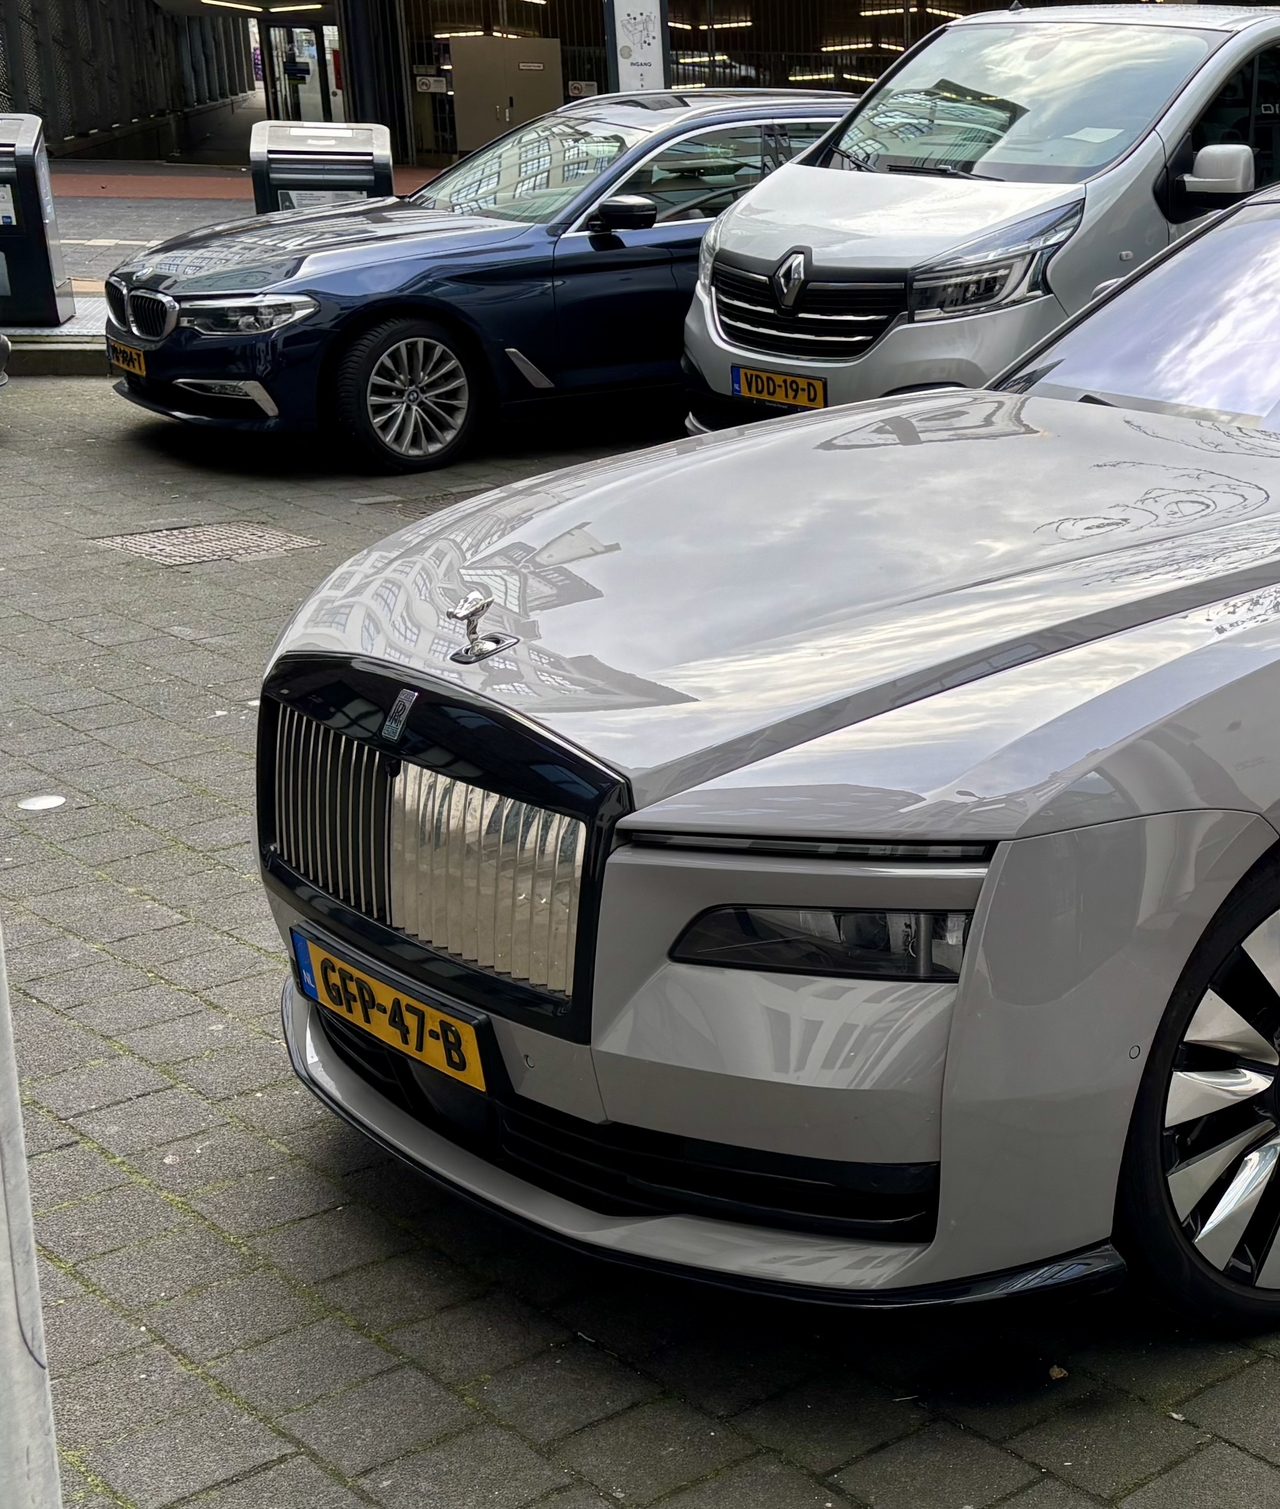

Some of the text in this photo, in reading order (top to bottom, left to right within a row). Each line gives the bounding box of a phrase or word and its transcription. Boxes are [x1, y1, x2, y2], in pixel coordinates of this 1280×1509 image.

[744, 372, 817, 403] VDD-19-D
[302, 969, 315, 988] NL
[320, 957, 467, 1072] GFP-47-B
